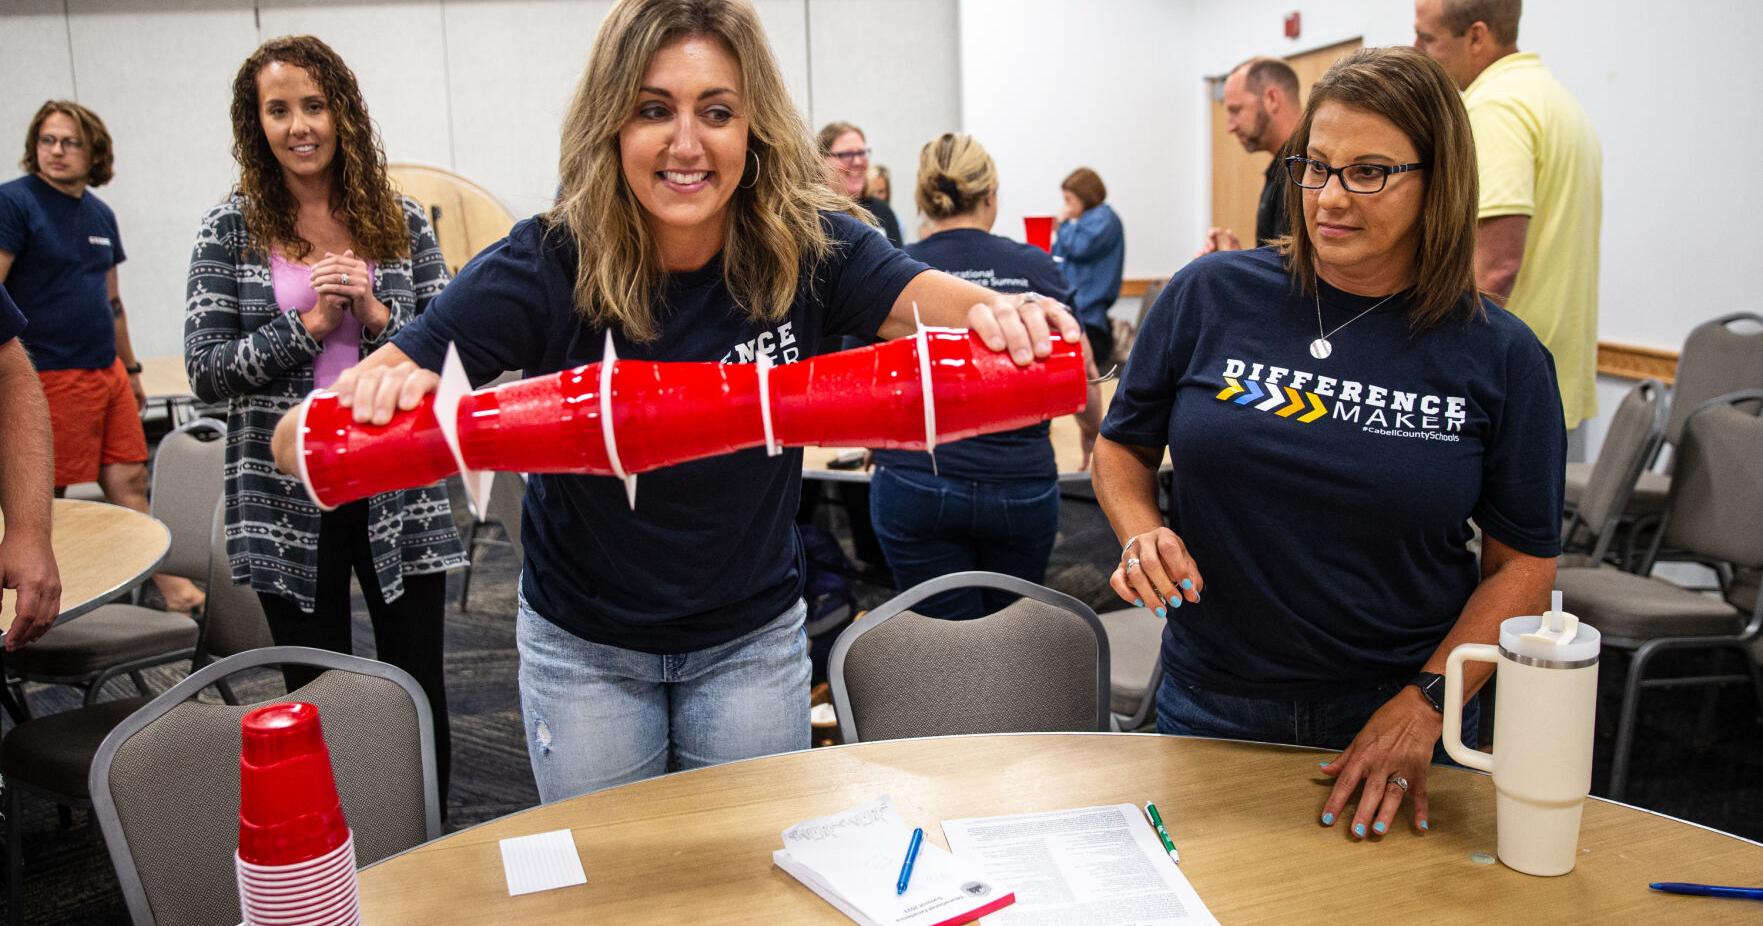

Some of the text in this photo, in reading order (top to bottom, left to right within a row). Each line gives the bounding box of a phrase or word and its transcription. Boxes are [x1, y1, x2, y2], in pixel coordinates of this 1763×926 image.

[990, 277, 1029, 288] Summit
[1223, 359, 1466, 419] DIFFERENCE
[1333, 401, 1466, 432] MAKER
[1362, 426, 1460, 442] #CabellCountySchools
